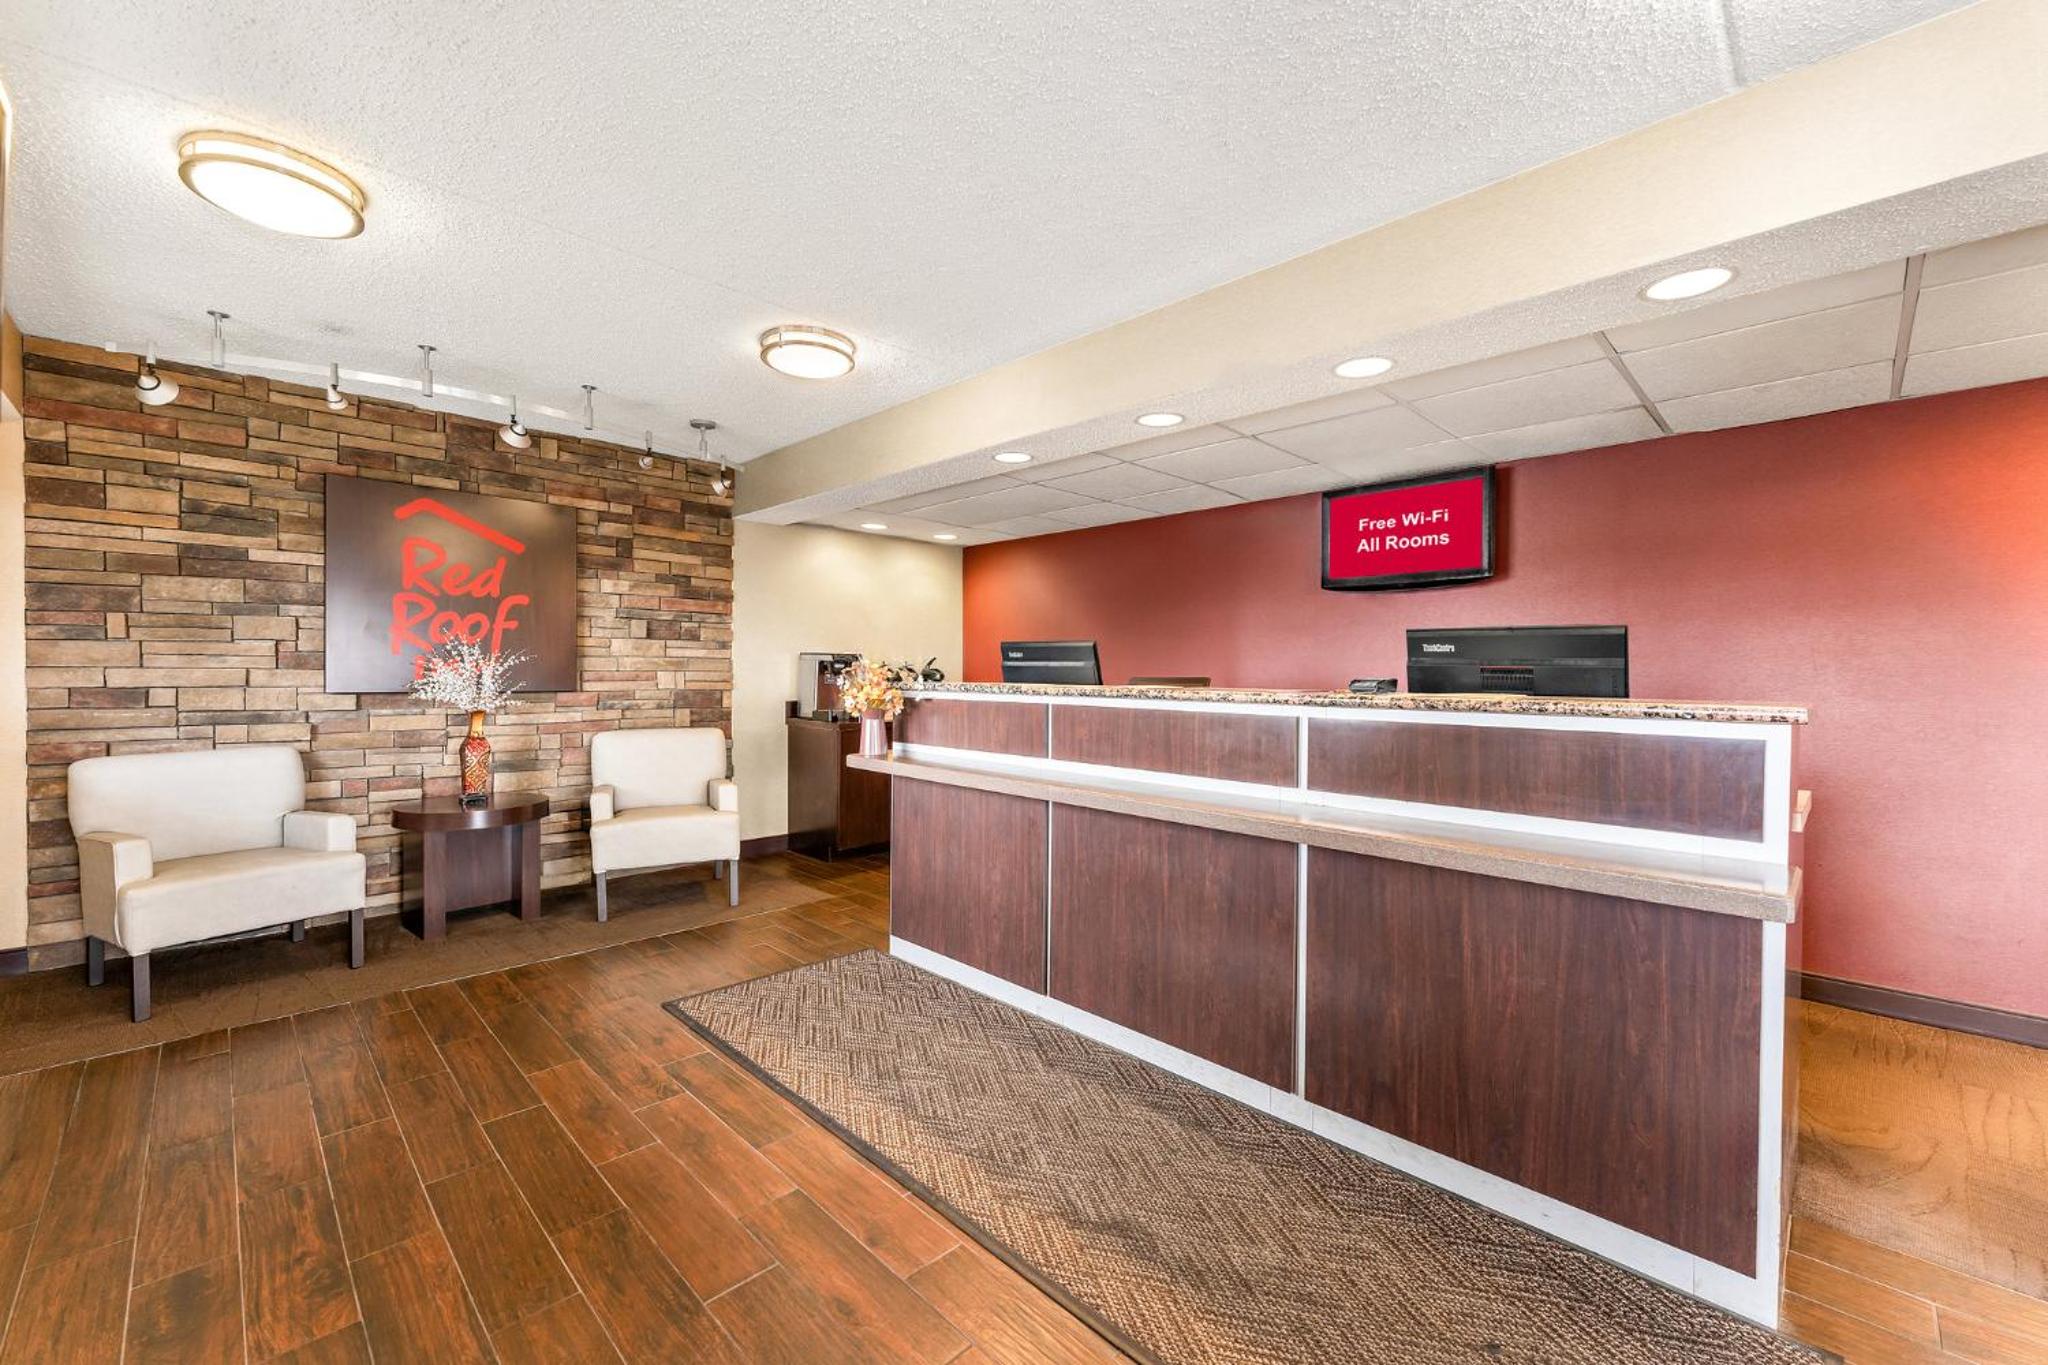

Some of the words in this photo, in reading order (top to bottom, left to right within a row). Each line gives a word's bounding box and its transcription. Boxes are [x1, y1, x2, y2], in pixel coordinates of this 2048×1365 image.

[1358, 517, 1397, 532] Free
[1401, 508, 1449, 527] Wi-Fi
[1356, 536, 1380, 553] All
[1385, 532, 1450, 550] Rooms
[401, 537, 507, 598] Red
[389, 592, 530, 660] Roof
